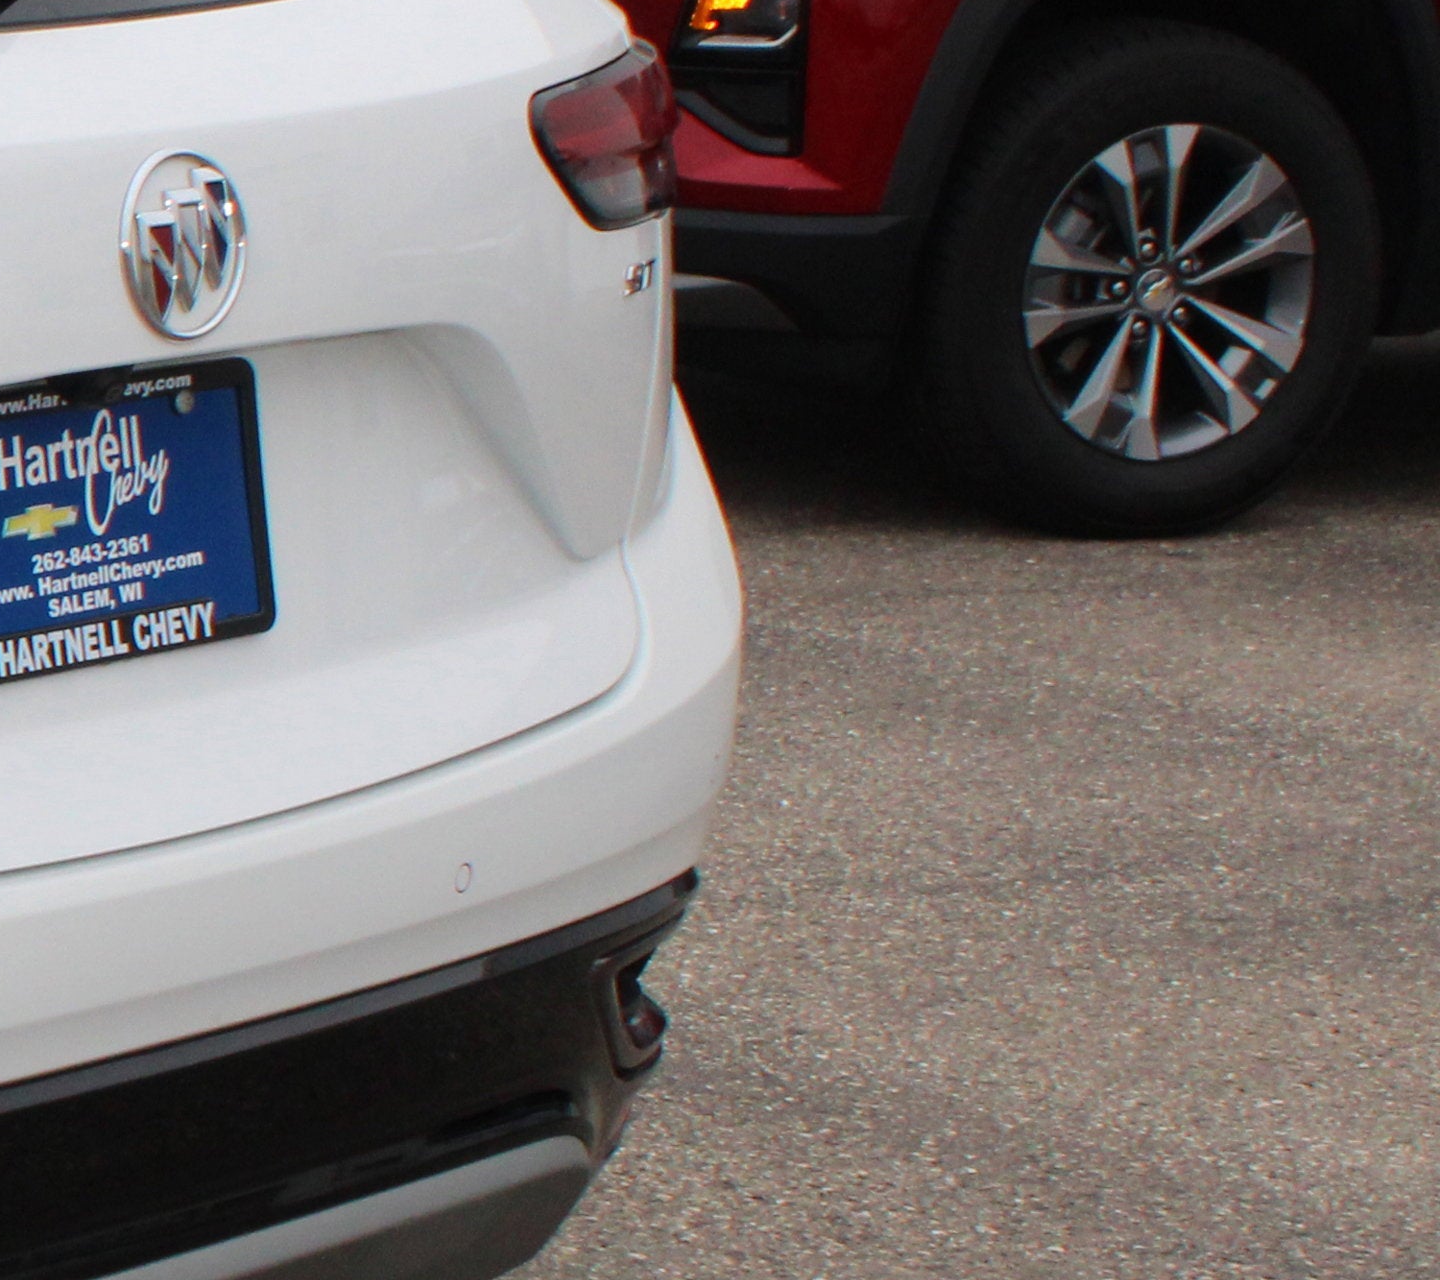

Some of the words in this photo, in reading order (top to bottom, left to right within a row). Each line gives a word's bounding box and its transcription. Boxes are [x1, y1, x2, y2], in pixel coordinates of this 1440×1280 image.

[84, 408, 170, 536] Chevy
[31, 533, 151, 575] 262-843-2361
[37, 550, 206, 597] HartnellChevy.com
[47, 588, 116, 618] SALEM,
[118, 581, 144, 603] WI
[131, 601, 216, 652] CHEVY
